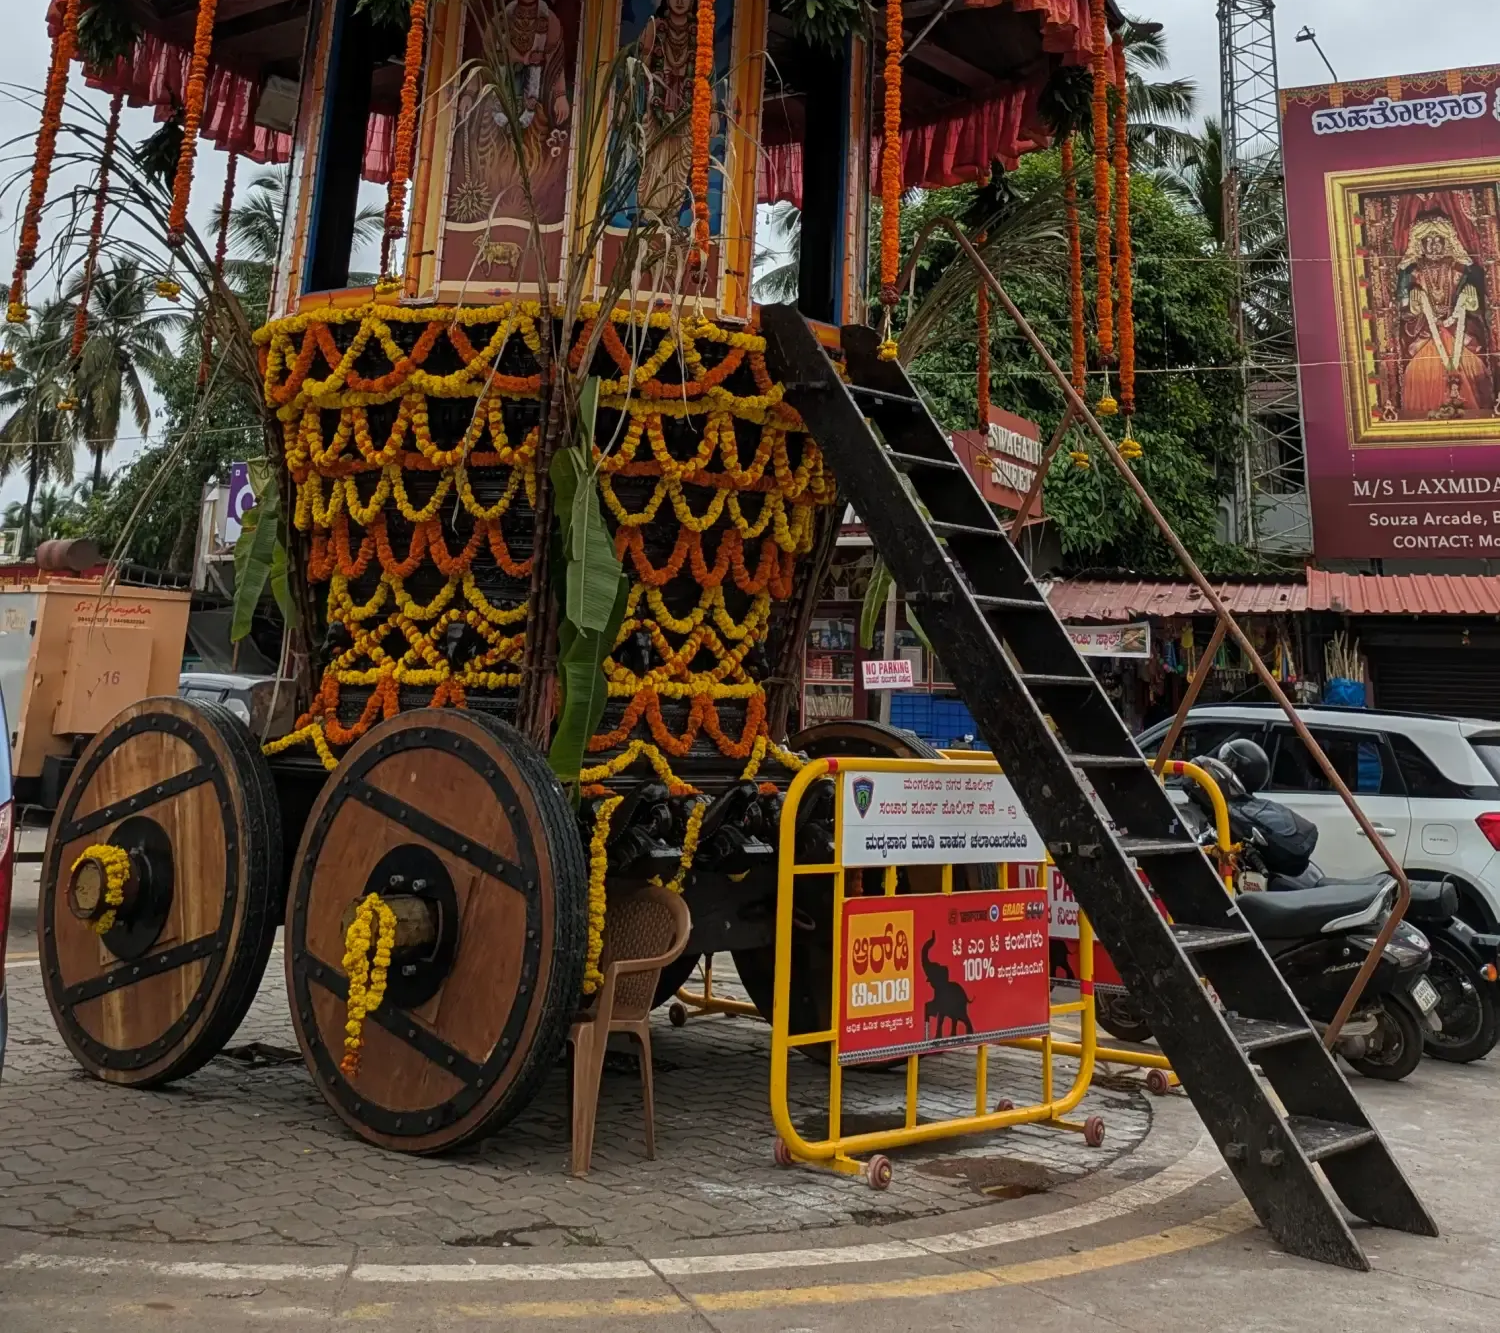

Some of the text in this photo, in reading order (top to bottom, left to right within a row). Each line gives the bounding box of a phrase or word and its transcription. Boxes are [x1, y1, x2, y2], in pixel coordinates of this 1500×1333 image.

[1315, 95, 1483, 131] ಮಹತೋಭಾರ
[1352, 478, 1394, 499] M/S
[1369, 512, 1418, 526] Souza
[1423, 511, 1488, 526] Arcade,
[1392, 535, 1474, 549] CONTACT:
[865, 661, 910, 675] NO PARKING
[103, 671, 120, 685] 16
[903, 778, 942, 791] ಮಂಗಳೂರು
[945, 778, 962, 791] ನಗರ
[879, 800, 908, 815] ಸಂಚಾರ
[911, 800, 938, 815] ಪೂರ್ವ
[979, 800, 996, 815] ಠಾಣೆ
[911, 833, 936, 850] ಮಾಡಿ
[939, 831, 967, 849] ವಾಹನ
[1003, 903, 1025, 916] GRADE
[952, 930, 1043, 956] ಟಿ ಎಂ ಟಿ ಕಂಬಿಗಳು
[963, 957, 995, 982] 100%
[851, 978, 910, 1007] ಟಿಎಂಟಿ
